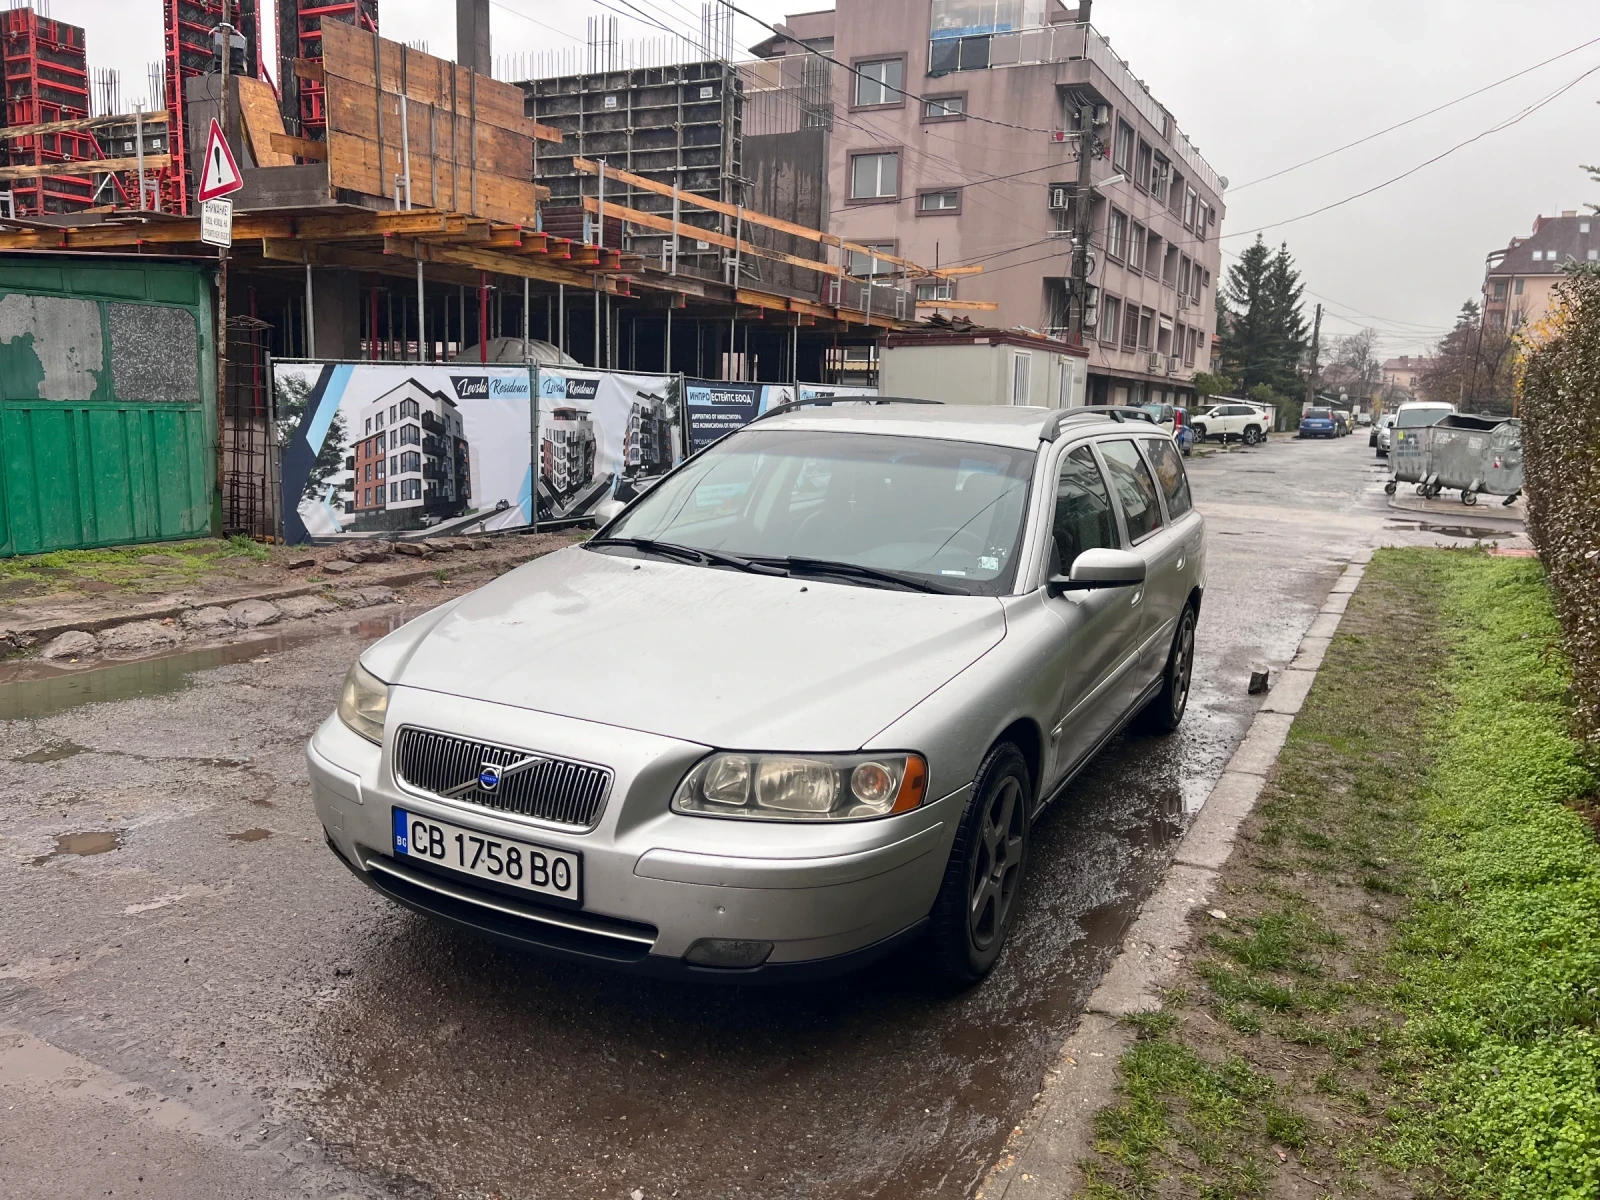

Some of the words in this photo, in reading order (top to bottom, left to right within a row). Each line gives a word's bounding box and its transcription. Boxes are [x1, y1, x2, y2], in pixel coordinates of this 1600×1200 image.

[457, 378, 487, 396] Levski
[489, 379, 528, 394] Residence
[542, 379, 566, 395] Levski
[566, 384, 595, 395] Residence
[711, 391, 735, 403] ЕСТЕЙТС
[735, 394, 752, 404] ЕООД
[396, 836, 407, 848] BG
[411, 821, 446, 859] CB
[455, 833, 523, 880] 1758
